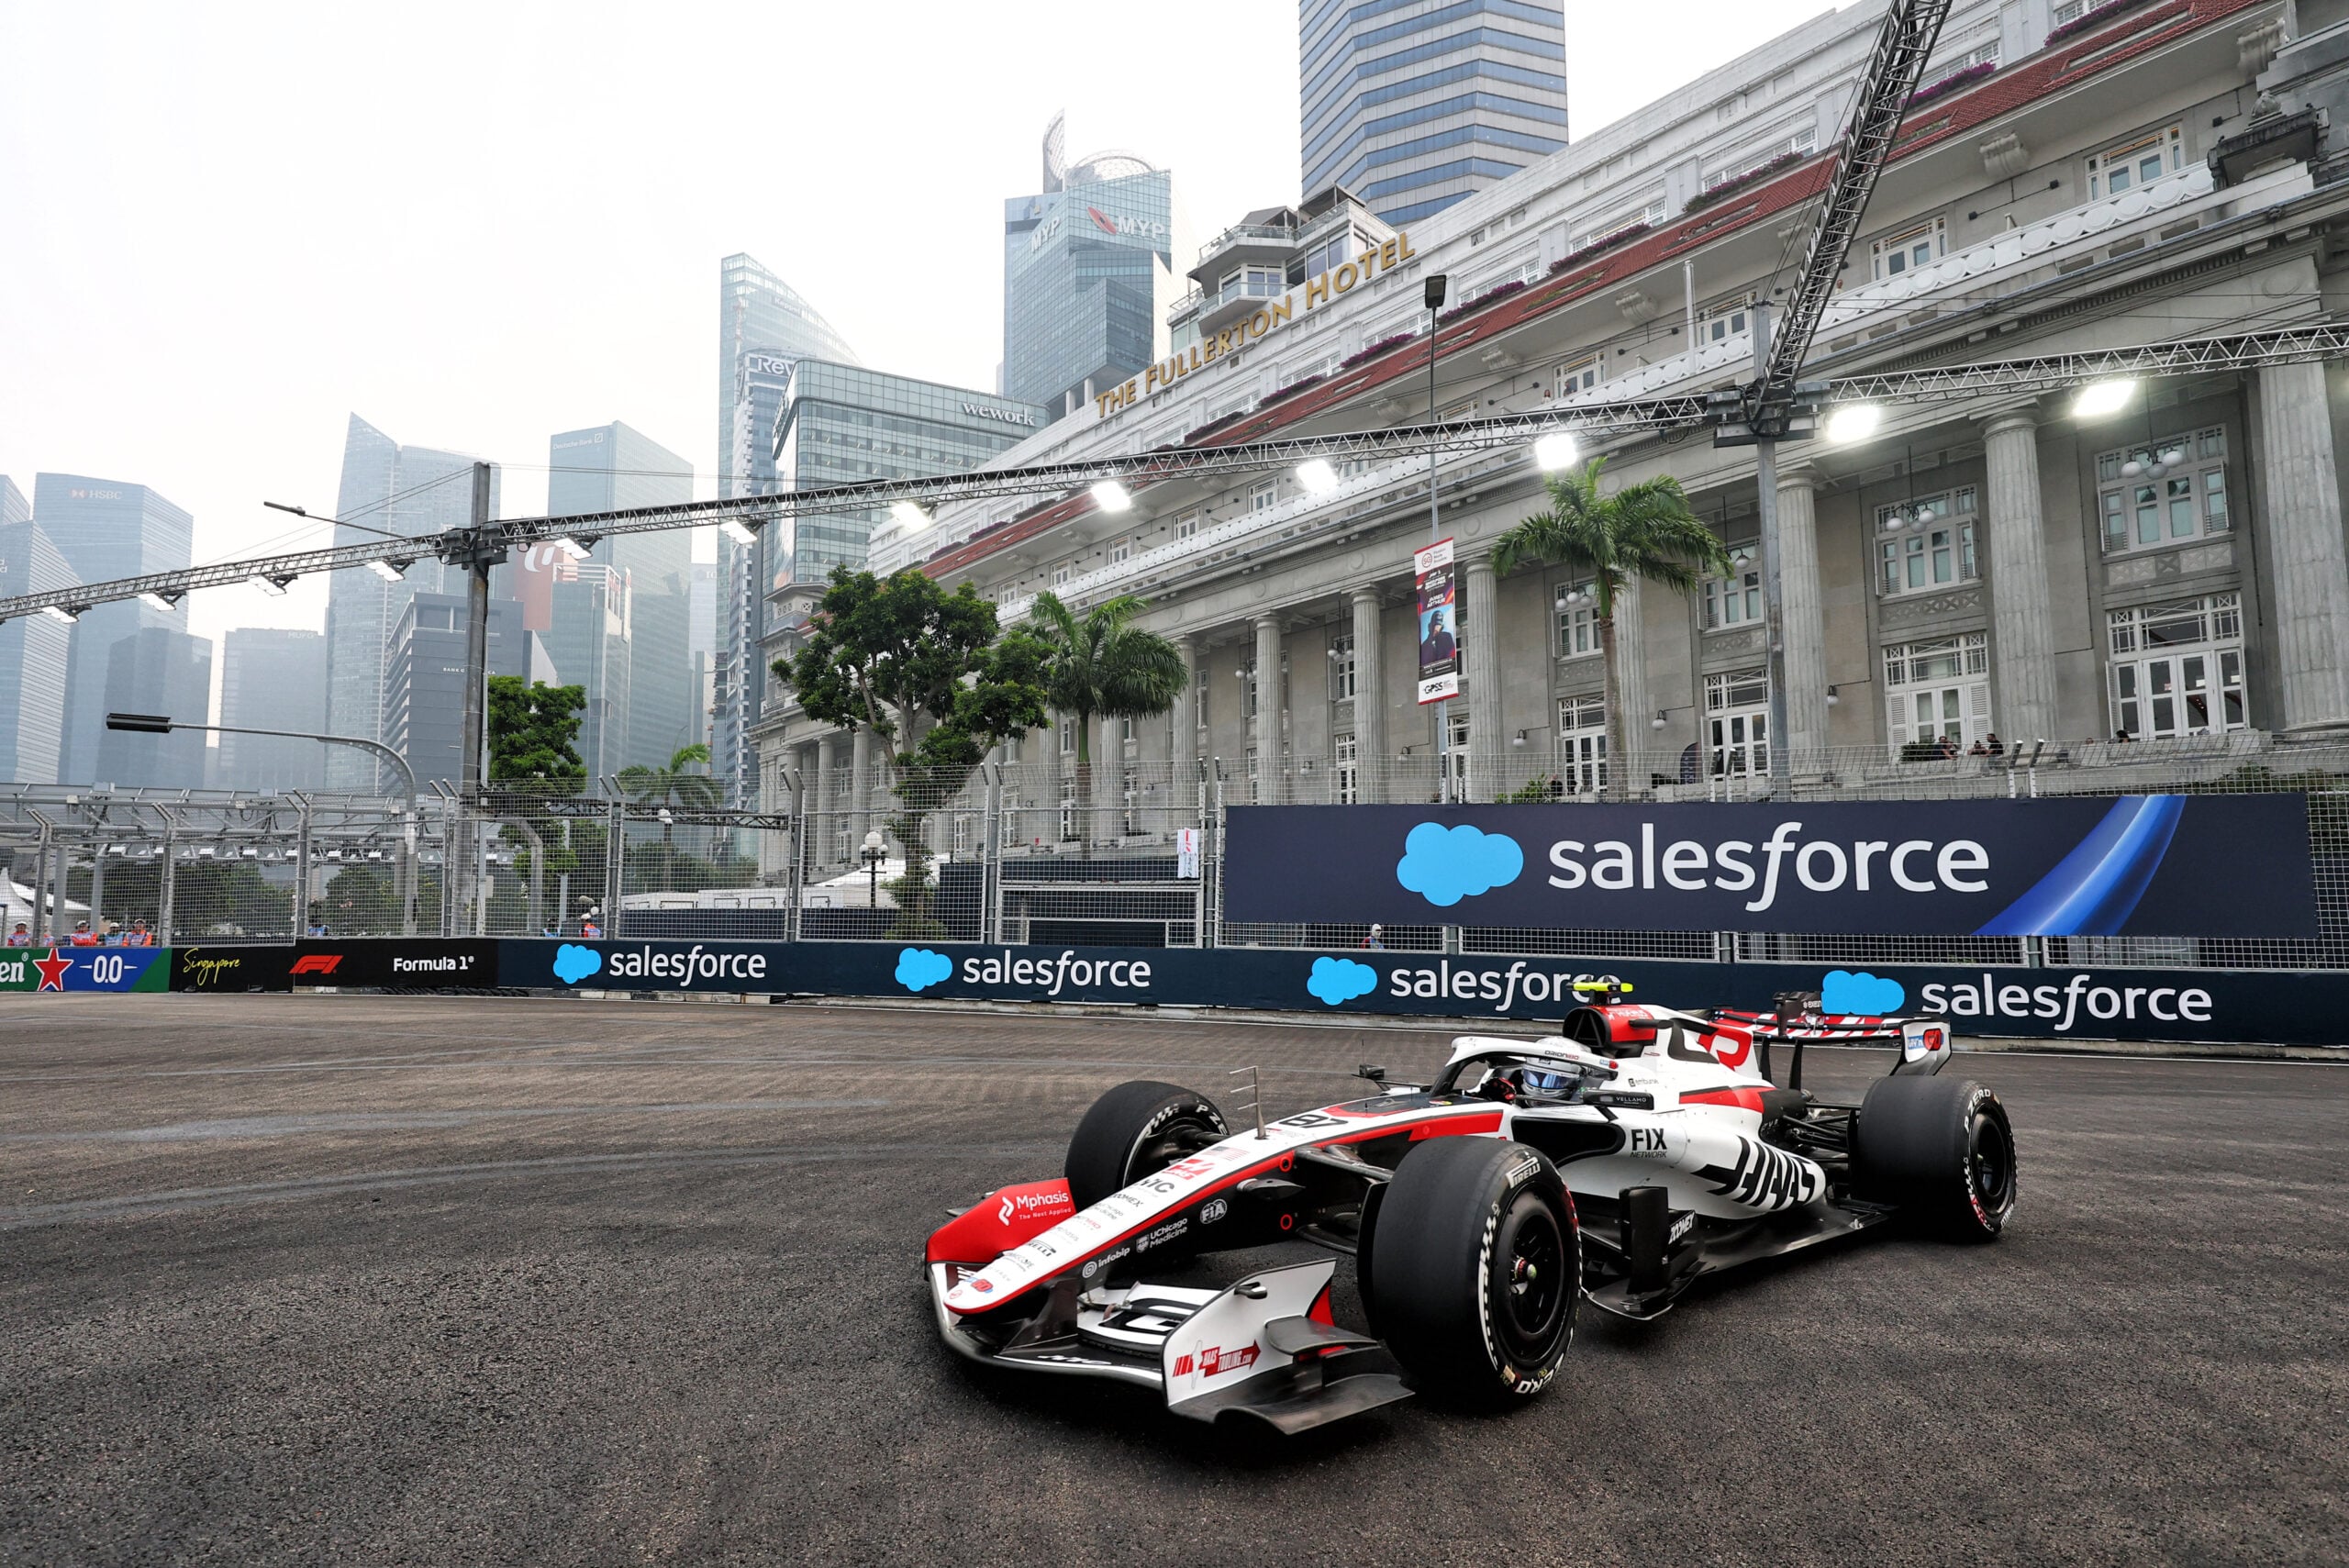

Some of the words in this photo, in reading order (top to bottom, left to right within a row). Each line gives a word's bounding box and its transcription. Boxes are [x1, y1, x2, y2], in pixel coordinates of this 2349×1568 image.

[1031, 217, 1060, 252] MYP
[1119, 216, 1166, 239] MYP
[1095, 379, 1136, 418] THE
[1146, 295, 1292, 395] FULLERTON
[1306, 231, 1416, 310] HOTEL
[963, 403, 1035, 426] wework
[89, 490, 122, 500] HSBC
[1548, 821, 1989, 912] salesforce
[184, 948, 241, 985] Singapore
[394, 957, 456, 972] Formula
[609, 945, 765, 986] salesforce
[963, 950, 1151, 995] salesforce
[1921, 973, 2212, 1031] salesforce
[1278, 1114, 1349, 1129] 87
[1631, 1129, 1667, 1151] FIX
[1506, 1156, 1542, 1189] PIRELLI
[1016, 1190, 1069, 1211] Mphasis
[1049, 1207, 1072, 1216] Applied
[1150, 1218, 1188, 1240] UChicago
[1150, 1226, 1188, 1249] Medicine
[1098, 1247, 1130, 1268] infobip
[1203, 1350, 1219, 1366] HAAS
